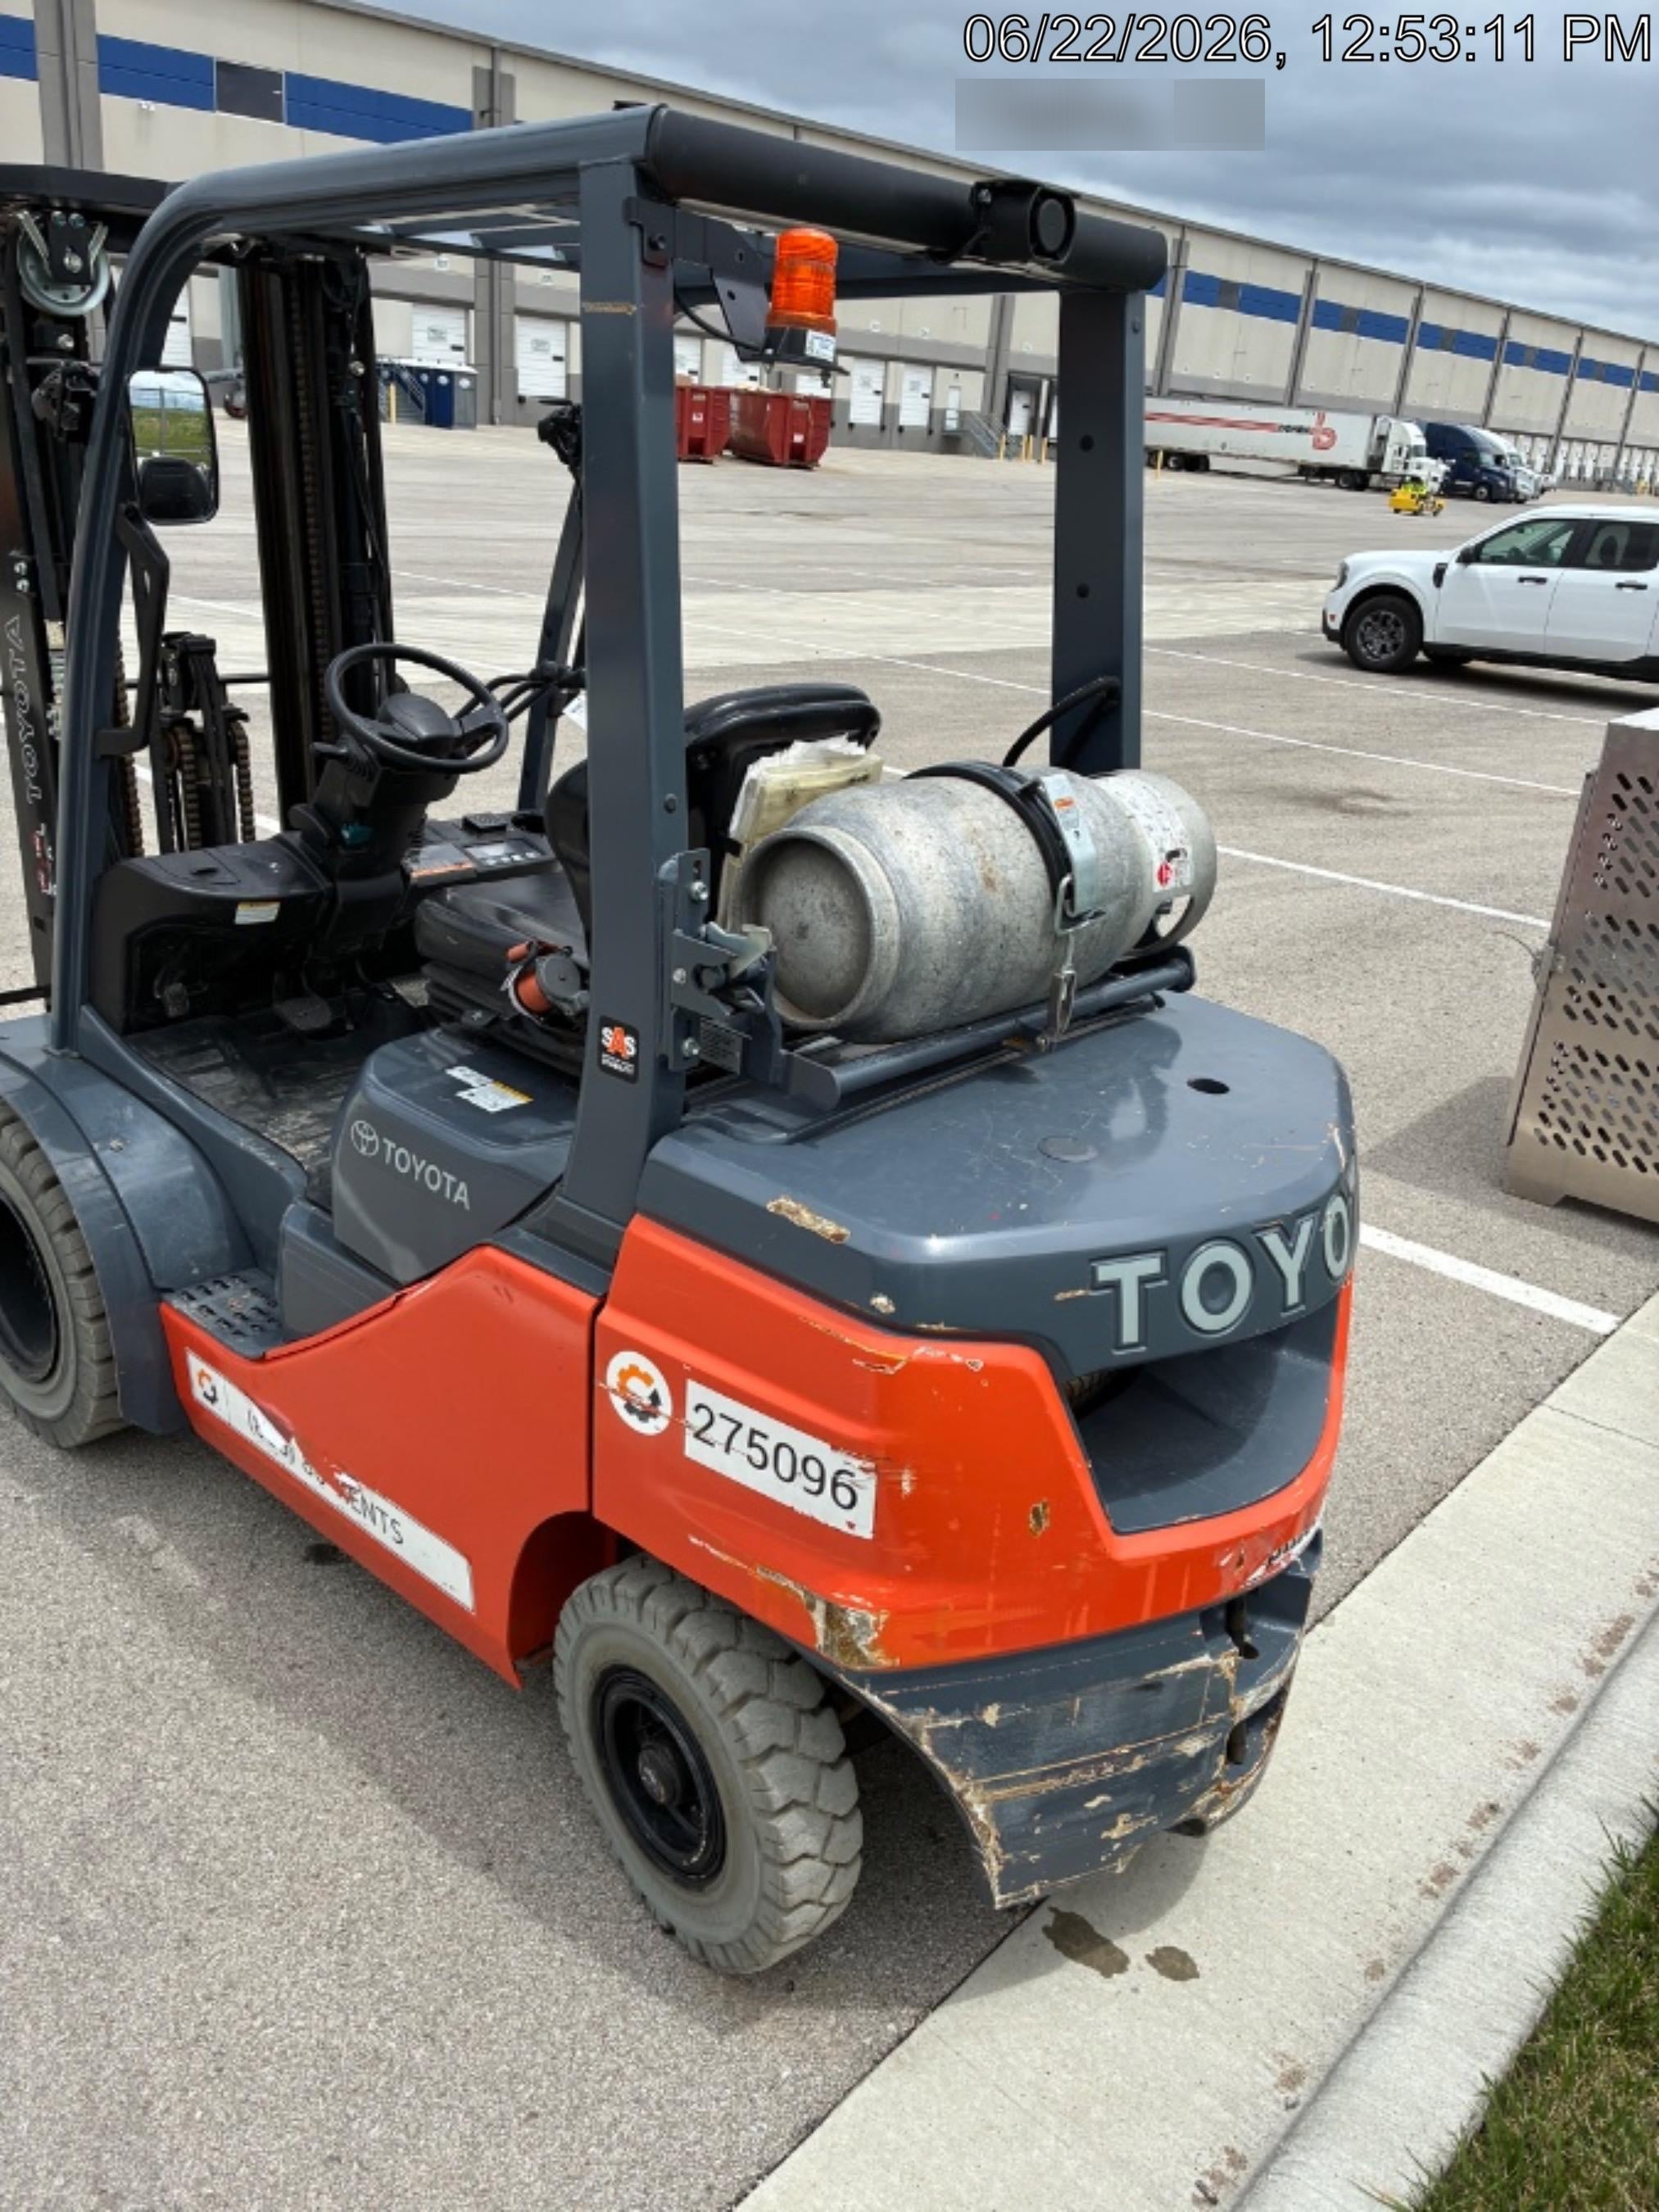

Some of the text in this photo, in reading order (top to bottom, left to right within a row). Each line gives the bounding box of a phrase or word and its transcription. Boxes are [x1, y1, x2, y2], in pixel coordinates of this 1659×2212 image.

[4, 613, 43, 806] TOYOTA
[382, 1136, 470, 1211] TOYOTA
[1093, 1172, 1356, 1350] TOYO
[691, 1402, 859, 1511] 275096
